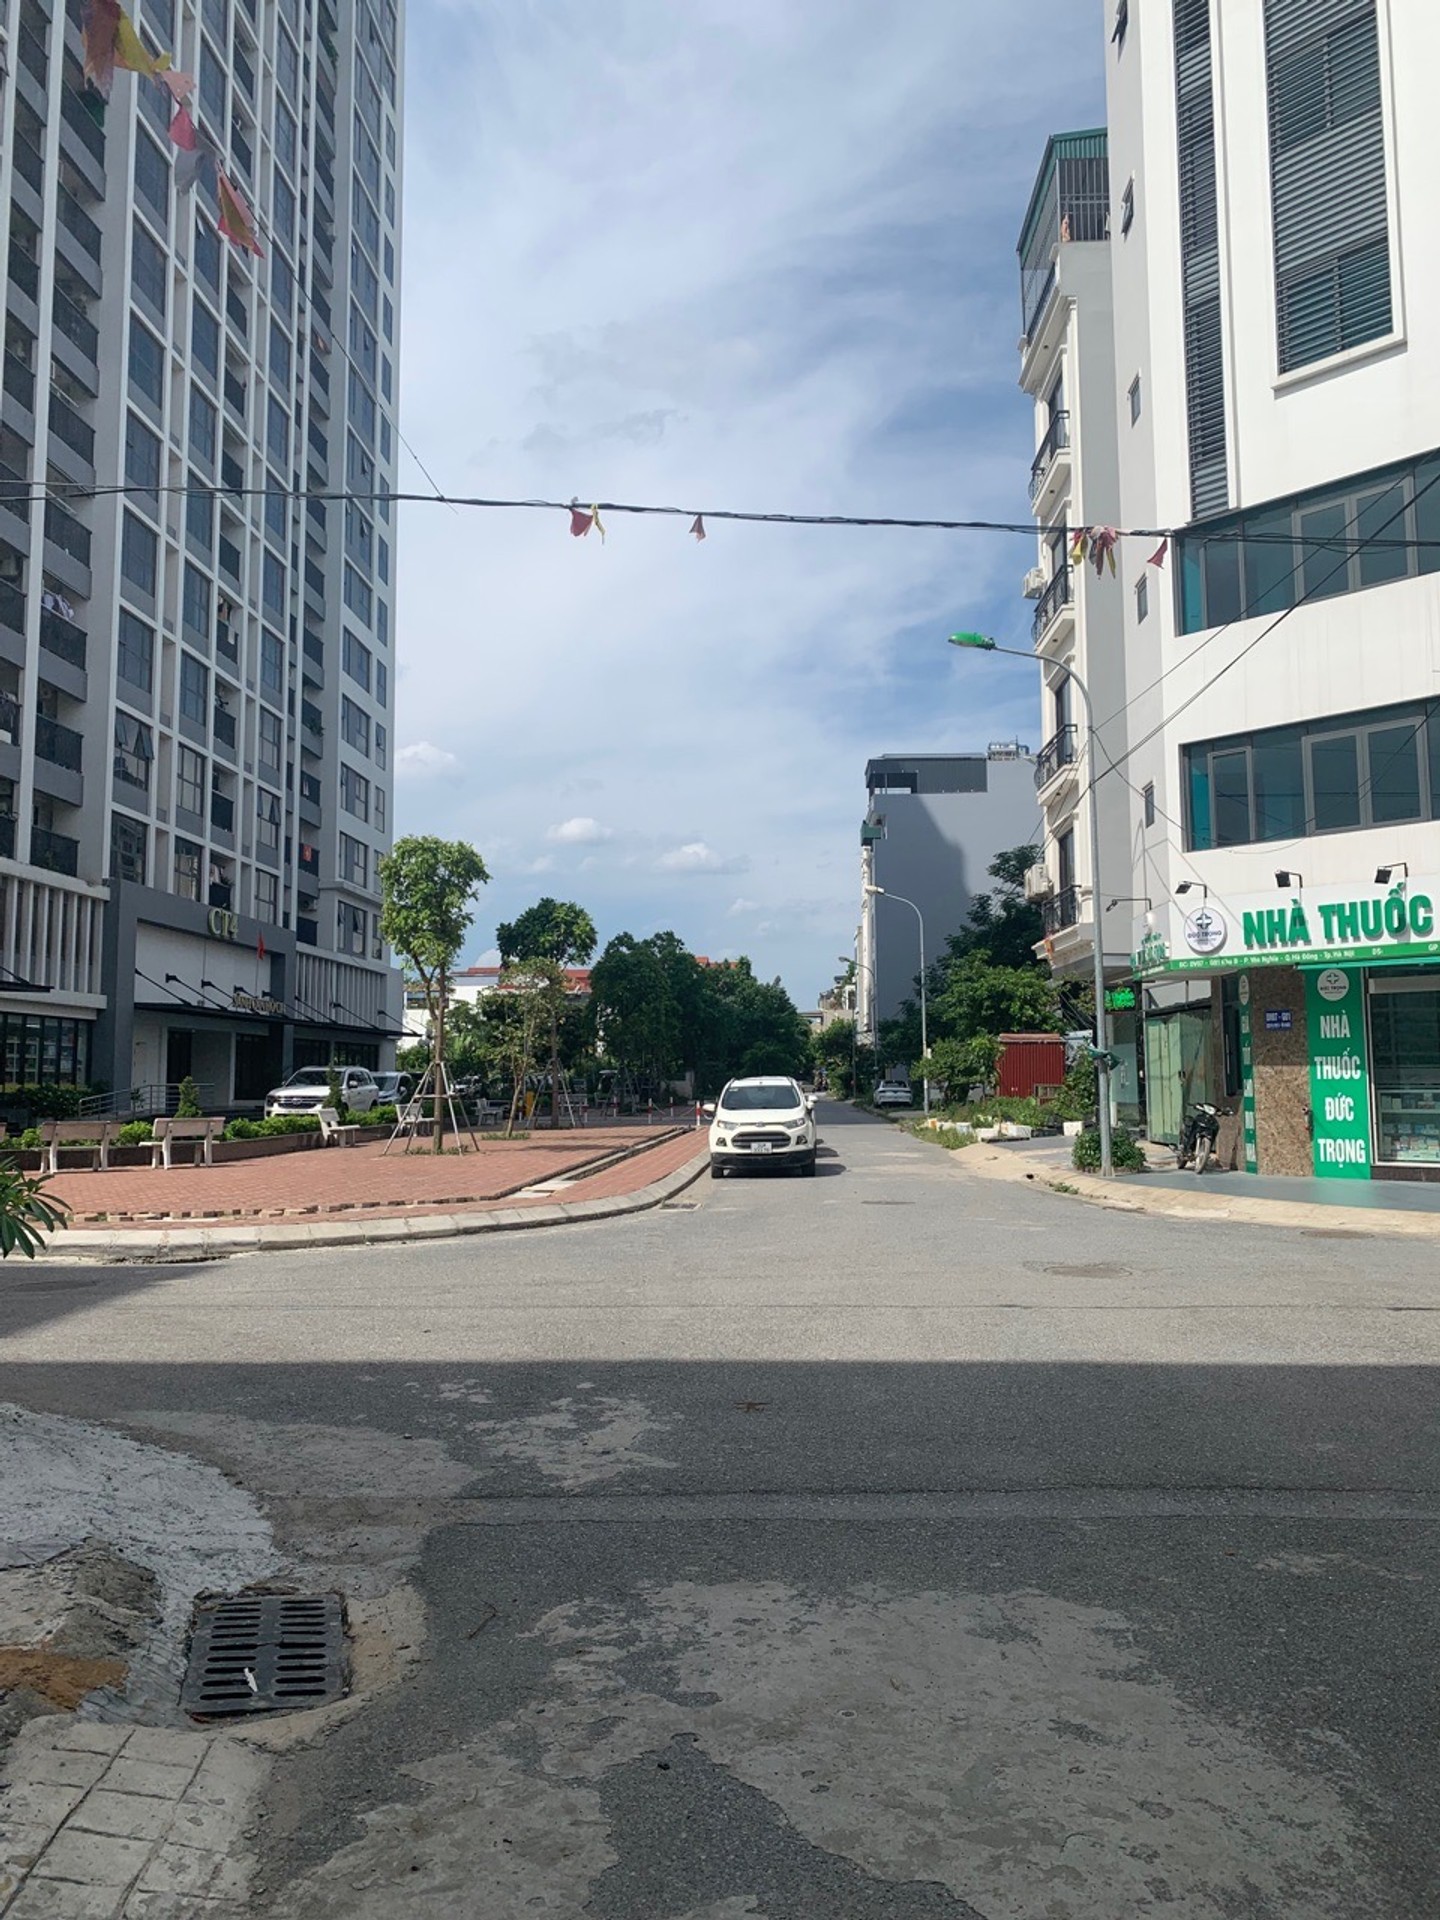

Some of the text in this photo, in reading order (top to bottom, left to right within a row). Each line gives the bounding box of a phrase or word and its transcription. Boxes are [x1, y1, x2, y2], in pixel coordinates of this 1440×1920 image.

[1242, 881, 1434, 947] NHÀ THUỐC
[1320, 1009, 1351, 1039] NHÀ
[1314, 1047, 1361, 1080] THUỐC
[1324, 1091, 1354, 1122] ĐỨC
[1317, 1138, 1366, 1168] TRỌNG
